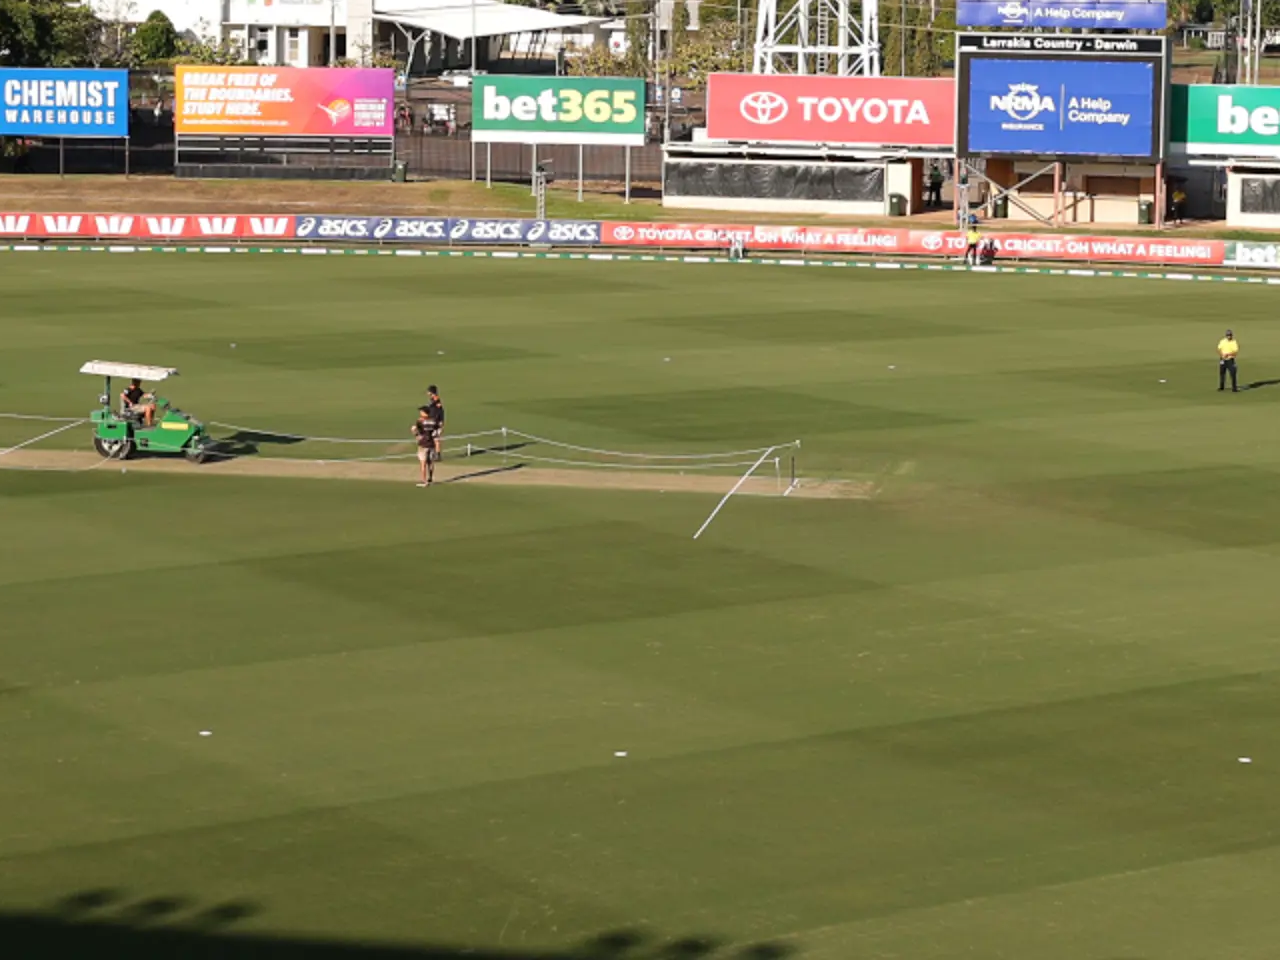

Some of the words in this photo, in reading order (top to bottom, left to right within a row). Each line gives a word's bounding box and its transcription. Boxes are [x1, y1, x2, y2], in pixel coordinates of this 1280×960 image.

[1034, 7, 1045, 17] A
[1045, 7, 1070, 19] Help
[1072, 7, 1125, 21] Company
[983, 37, 1032, 49] Larrakia
[1033, 38, 1083, 51] Country
[1095, 39, 1138, 51] Darwin
[5, 79, 119, 108] CHEMIST
[183, 101, 223, 115] STUDY
[483, 85, 637, 124] bet365
[797, 96, 931, 125] TOYOTA
[989, 94, 1056, 112] NRMA
[1068, 97, 1081, 109] A
[1083, 97, 1112, 112] Help
[5, 109, 116, 125] WAREHOUSE
[1068, 110, 1130, 126] Company
[638, 227, 693, 241] TOYOTA
[782, 231, 823, 245] WHAT
[824, 233, 834, 245] A
[836, 232, 897, 246] FEELING!
[1067, 240, 1089, 253] OH
[1092, 242, 1134, 255] WHAT
[1135, 244, 1146, 256] A
[1148, 244, 1212, 258] FEELING!
